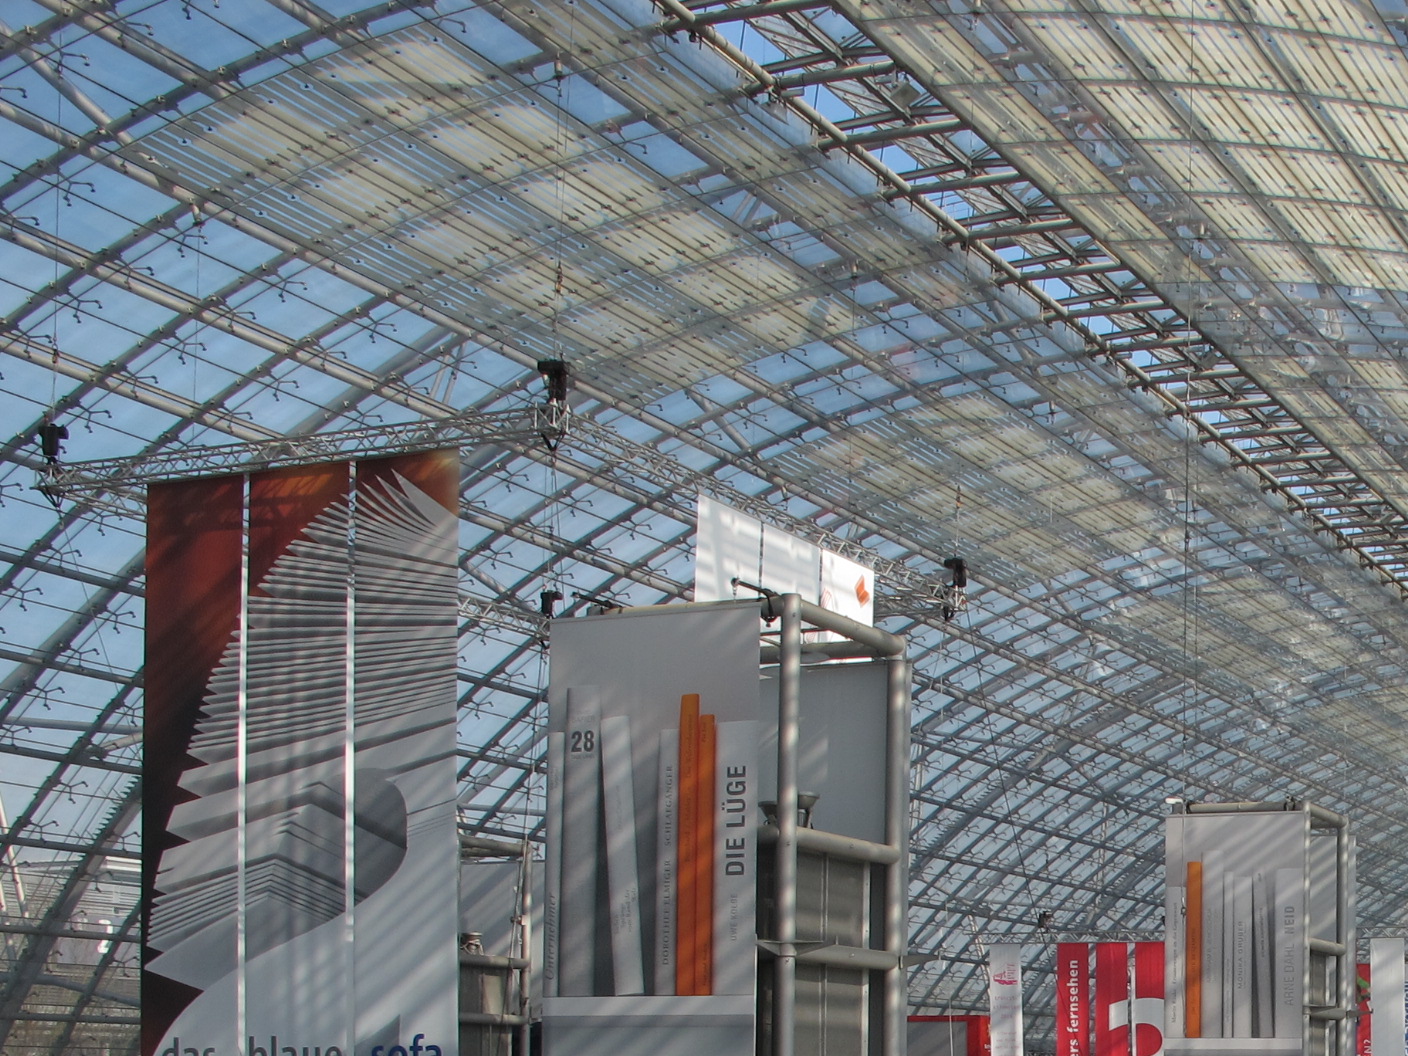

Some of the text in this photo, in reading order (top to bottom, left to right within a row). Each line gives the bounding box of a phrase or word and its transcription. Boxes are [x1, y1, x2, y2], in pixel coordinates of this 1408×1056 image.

[571, 730, 595, 752] 28
[722, 766, 746, 875] DIE LÜGE
[545, 892, 556, 980] Unternehmer
[1284, 906, 1295, 1006] ARNE DAHL NEID
[1066, 959, 1079, 1033] fernsehen
